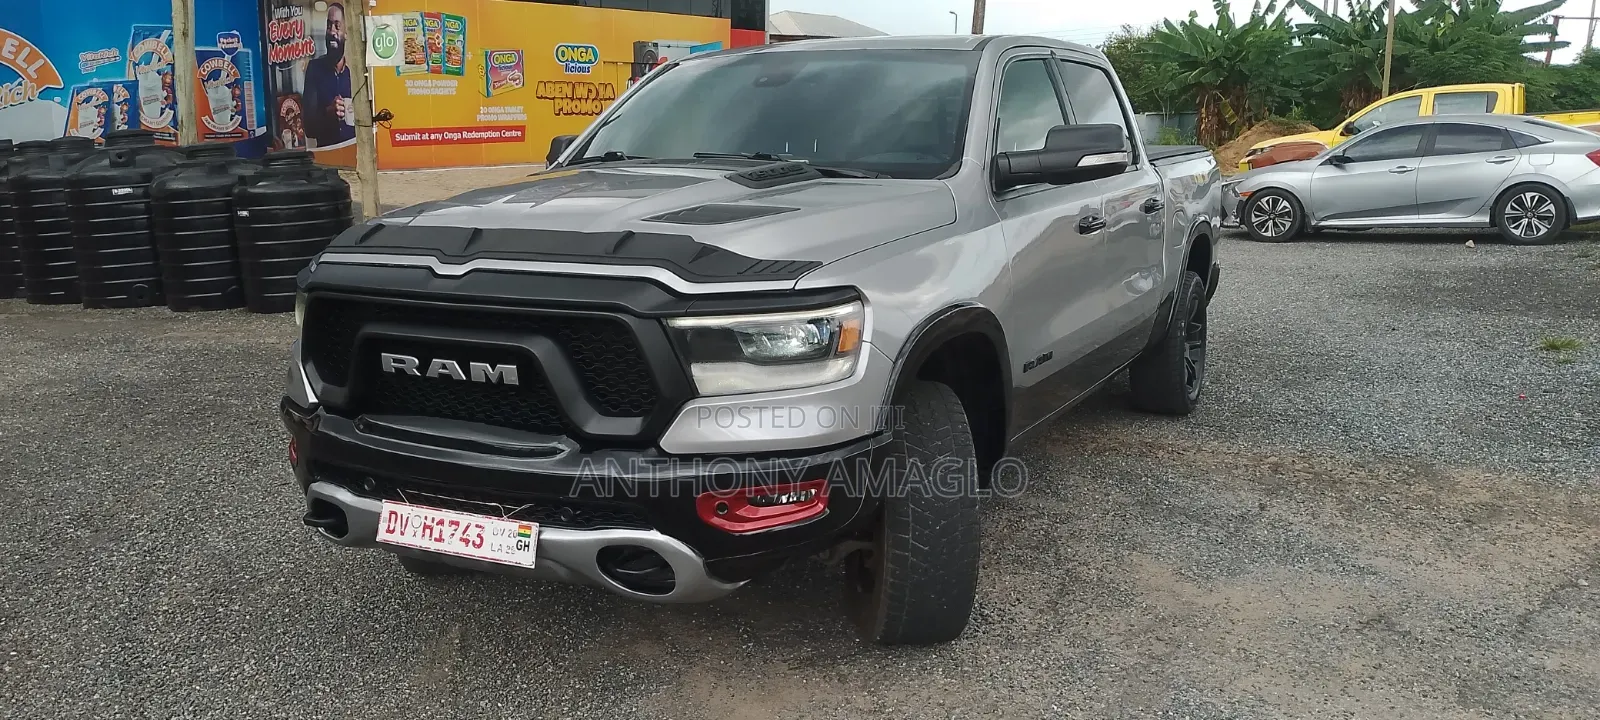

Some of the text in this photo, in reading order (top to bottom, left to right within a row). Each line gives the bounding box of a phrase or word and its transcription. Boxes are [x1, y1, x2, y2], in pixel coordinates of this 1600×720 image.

[275, 5, 303, 18] With You
[269, 20, 304, 42] Every
[403, 19, 417, 27] NGA
[445, 21, 459, 29] NGA
[134, 40, 170, 60] COWBELL
[268, 36, 315, 65] Moment
[375, 33, 394, 52] glo
[493, 53, 516, 64] ONGA
[557, 45, 596, 62] ONGA
[200, 59, 237, 76] COWBELL
[565, 63, 590, 74] licious
[414, 79, 431, 87] ONGA
[536, 81, 573, 99] ABEN
[553, 99, 603, 116] PROMO
[395, 129, 522, 141] Submit at any Onga Redemption Centre
[380, 352, 519, 385] RAM
[385, 510, 410, 536] DV
[515, 539, 531, 552] GH
